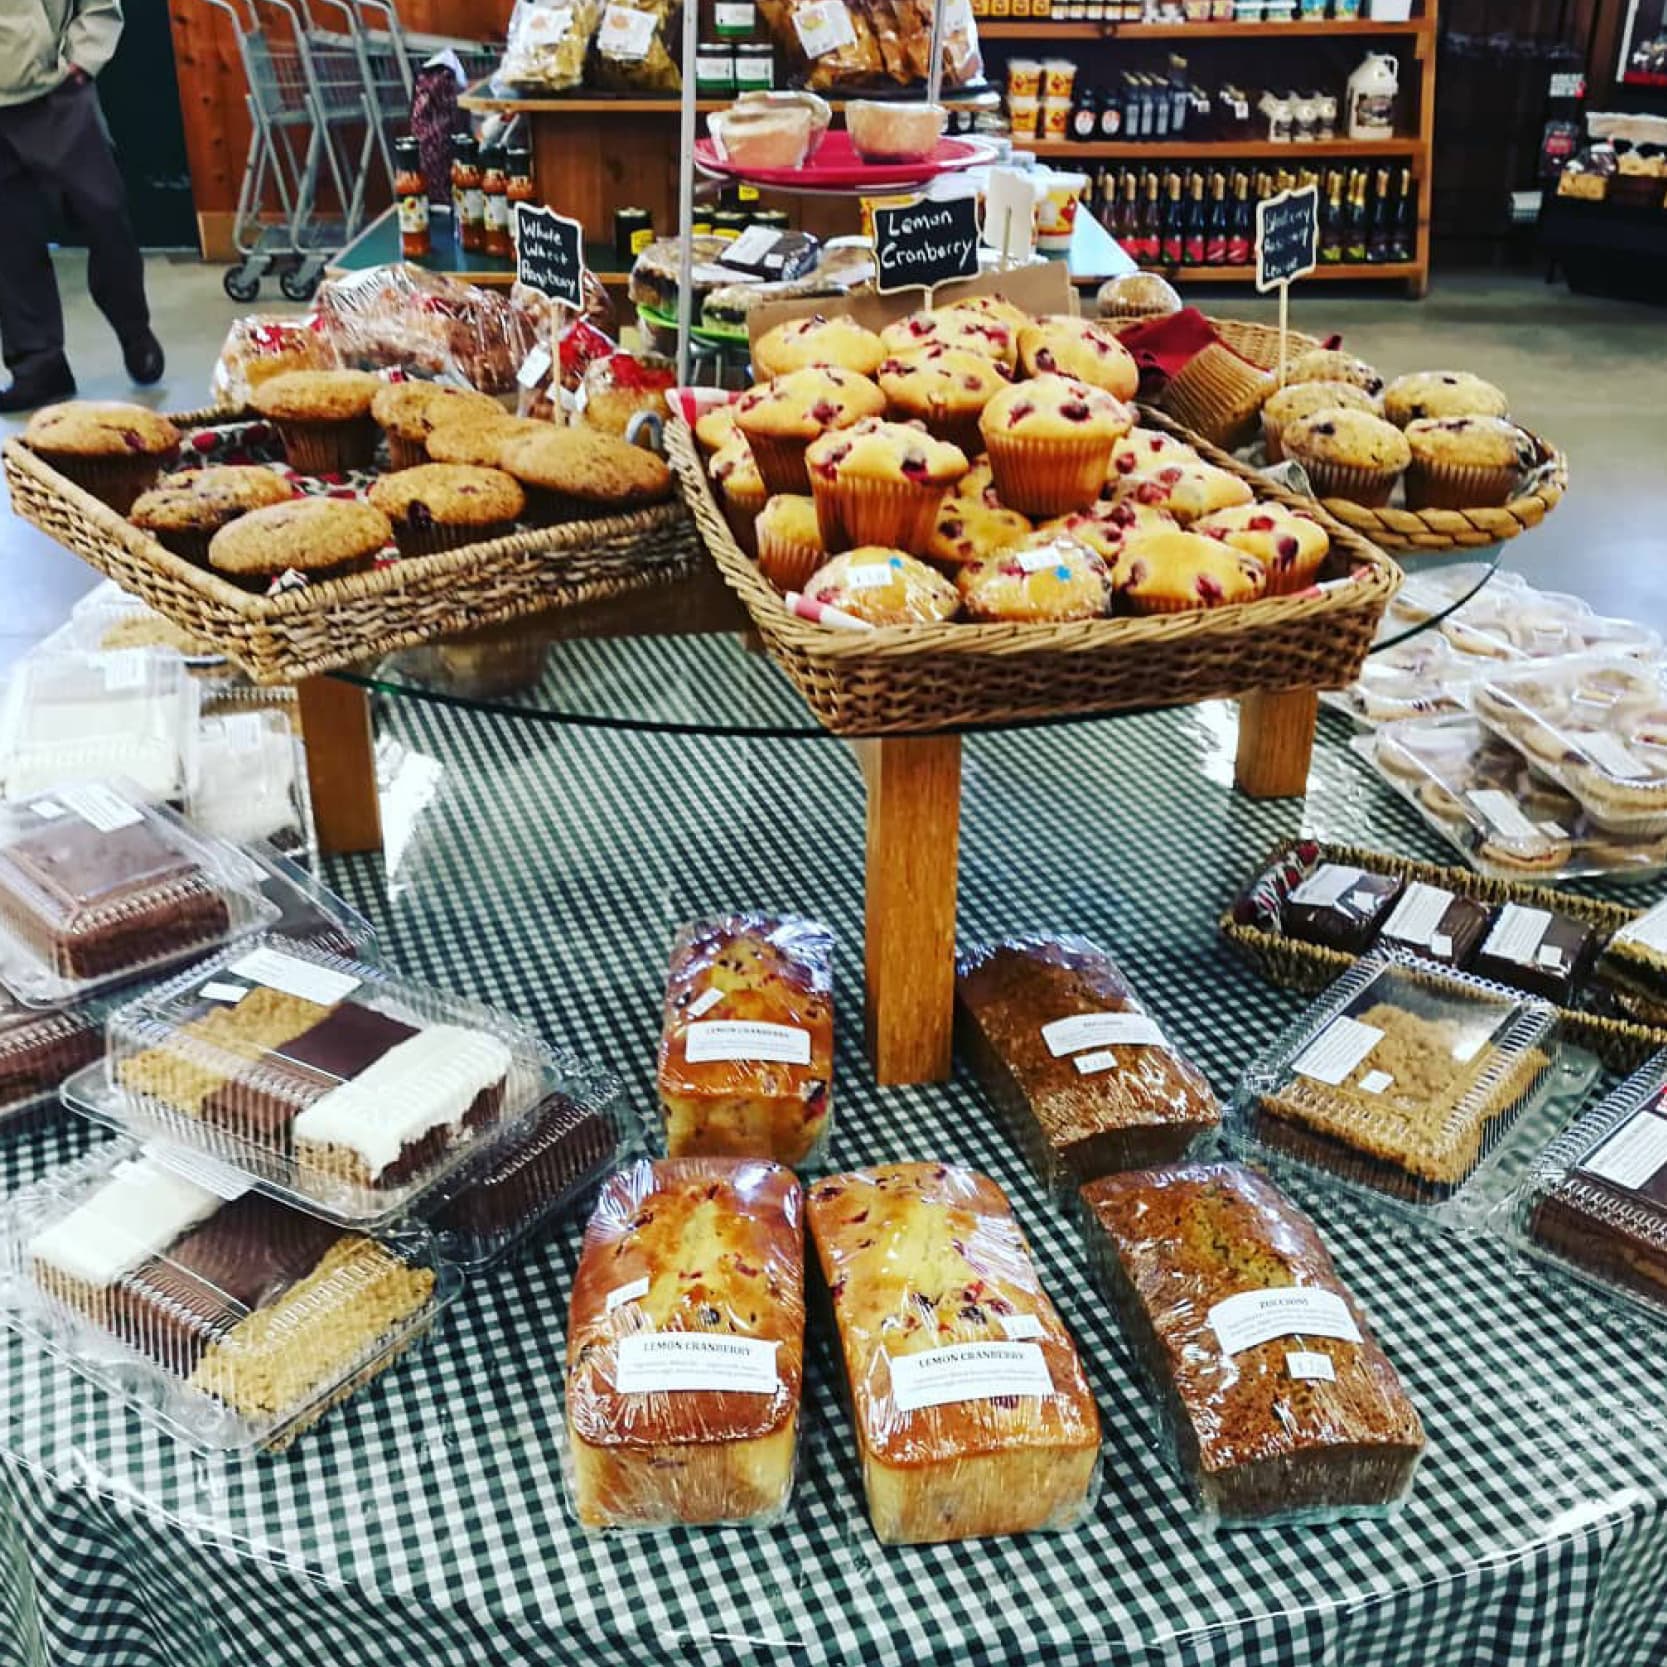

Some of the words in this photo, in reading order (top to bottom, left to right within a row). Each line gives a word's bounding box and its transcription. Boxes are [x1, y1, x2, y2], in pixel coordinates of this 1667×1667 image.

[521, 216, 563, 247] Whole
[888, 210, 954, 237] Lemon
[881, 239, 974, 271] Cranberry
[643, 1339, 683, 1352] LEMON
[685, 1341, 751, 1357] CRANBERRY
[918, 1351, 958, 1369] LEMON
[960, 1350, 1025, 1362] CRANBERRY
